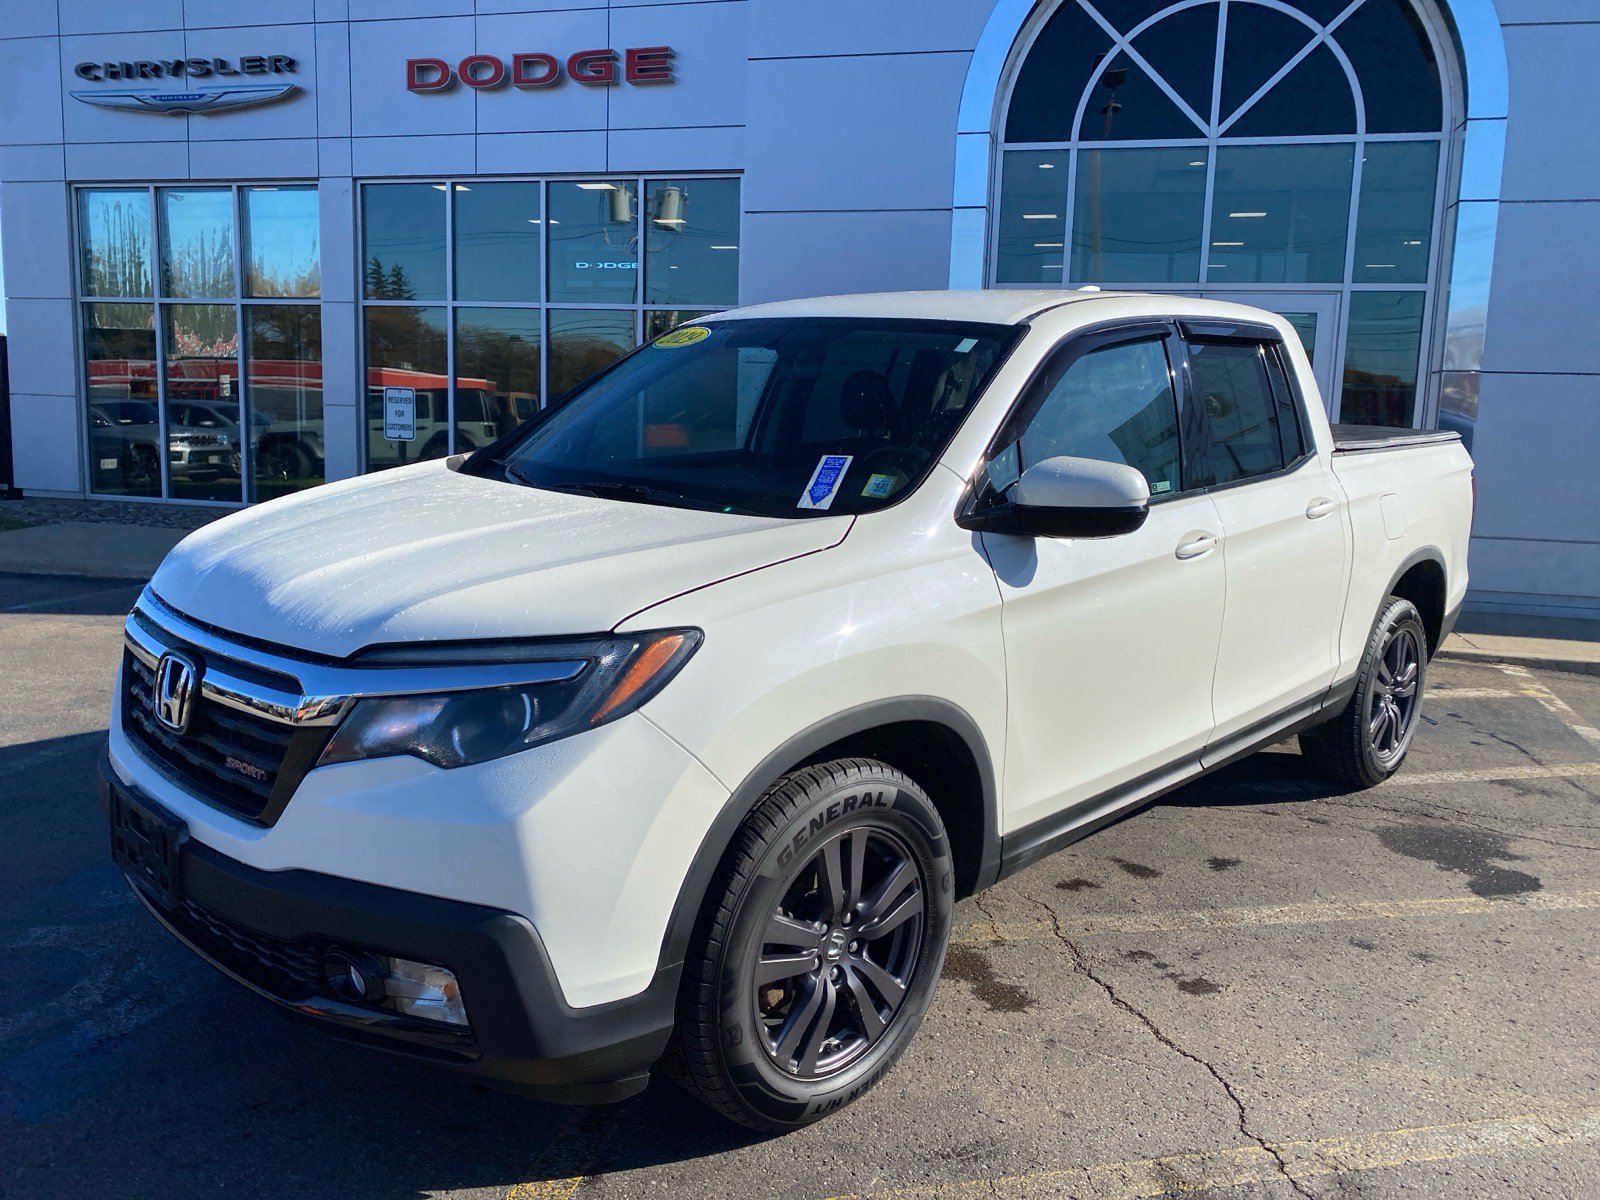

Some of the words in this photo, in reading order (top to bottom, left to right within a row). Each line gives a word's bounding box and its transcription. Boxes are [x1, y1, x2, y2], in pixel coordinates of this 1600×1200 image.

[74, 54, 296, 80] CHRYSLER
[406, 46, 672, 92] DODGE
[387, 396, 412, 405] RESERVED
[394, 409, 405, 418] FOR
[386, 423, 412, 431] CUSTOMERS
[225, 756, 265, 780] SPORT
[776, 790, 889, 871] GENERAL
